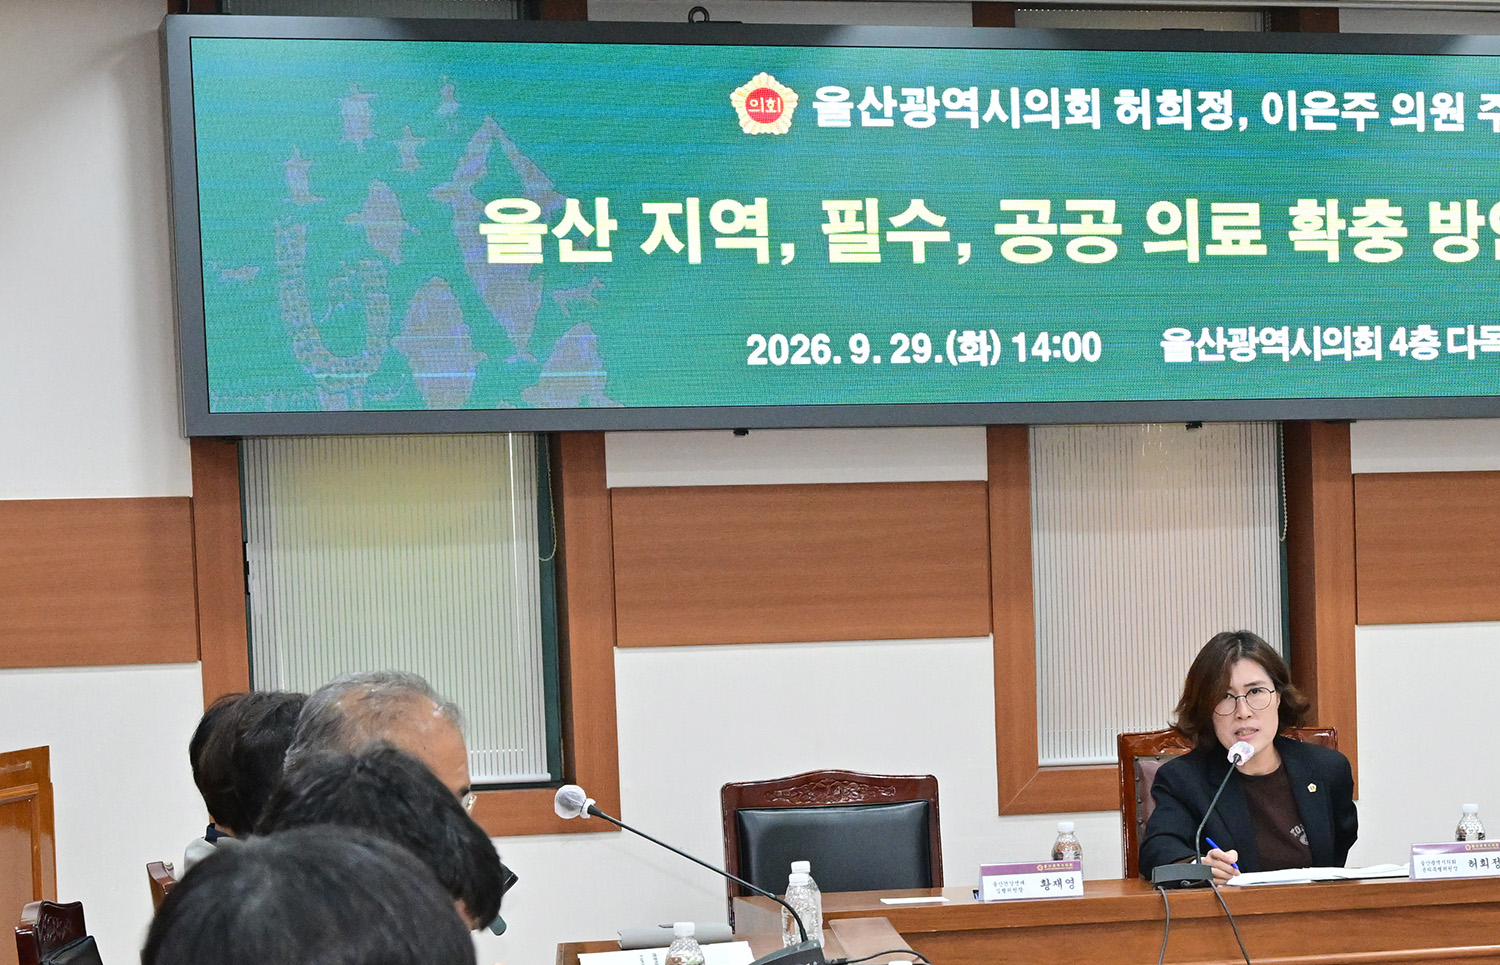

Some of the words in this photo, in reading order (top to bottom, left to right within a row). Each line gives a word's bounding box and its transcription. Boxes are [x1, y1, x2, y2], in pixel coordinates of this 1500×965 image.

[748, 97, 782, 113] 의회
[812, 85, 1101, 130] 울산광역시의회
[1113, 88, 1248, 132] 허희정,
[1261, 90, 1380, 132] 이은주
[1390, 91, 1465, 133] 의원
[479, 197, 618, 264] 울산
[640, 197, 795, 265] 지역,
[821, 197, 971, 265] 필수,
[994, 199, 1123, 264] 공공
[1143, 198, 1268, 263] 의료
[1288, 198, 1408, 263] 확충
[746, 333, 842, 366] 2026.
[1011, 331, 1102, 363] 14:00
[1160, 325, 1382, 363] 울산광역시의회
[1389, 324, 1442, 361] 4층
[1040, 877, 1075, 892] 황재영
